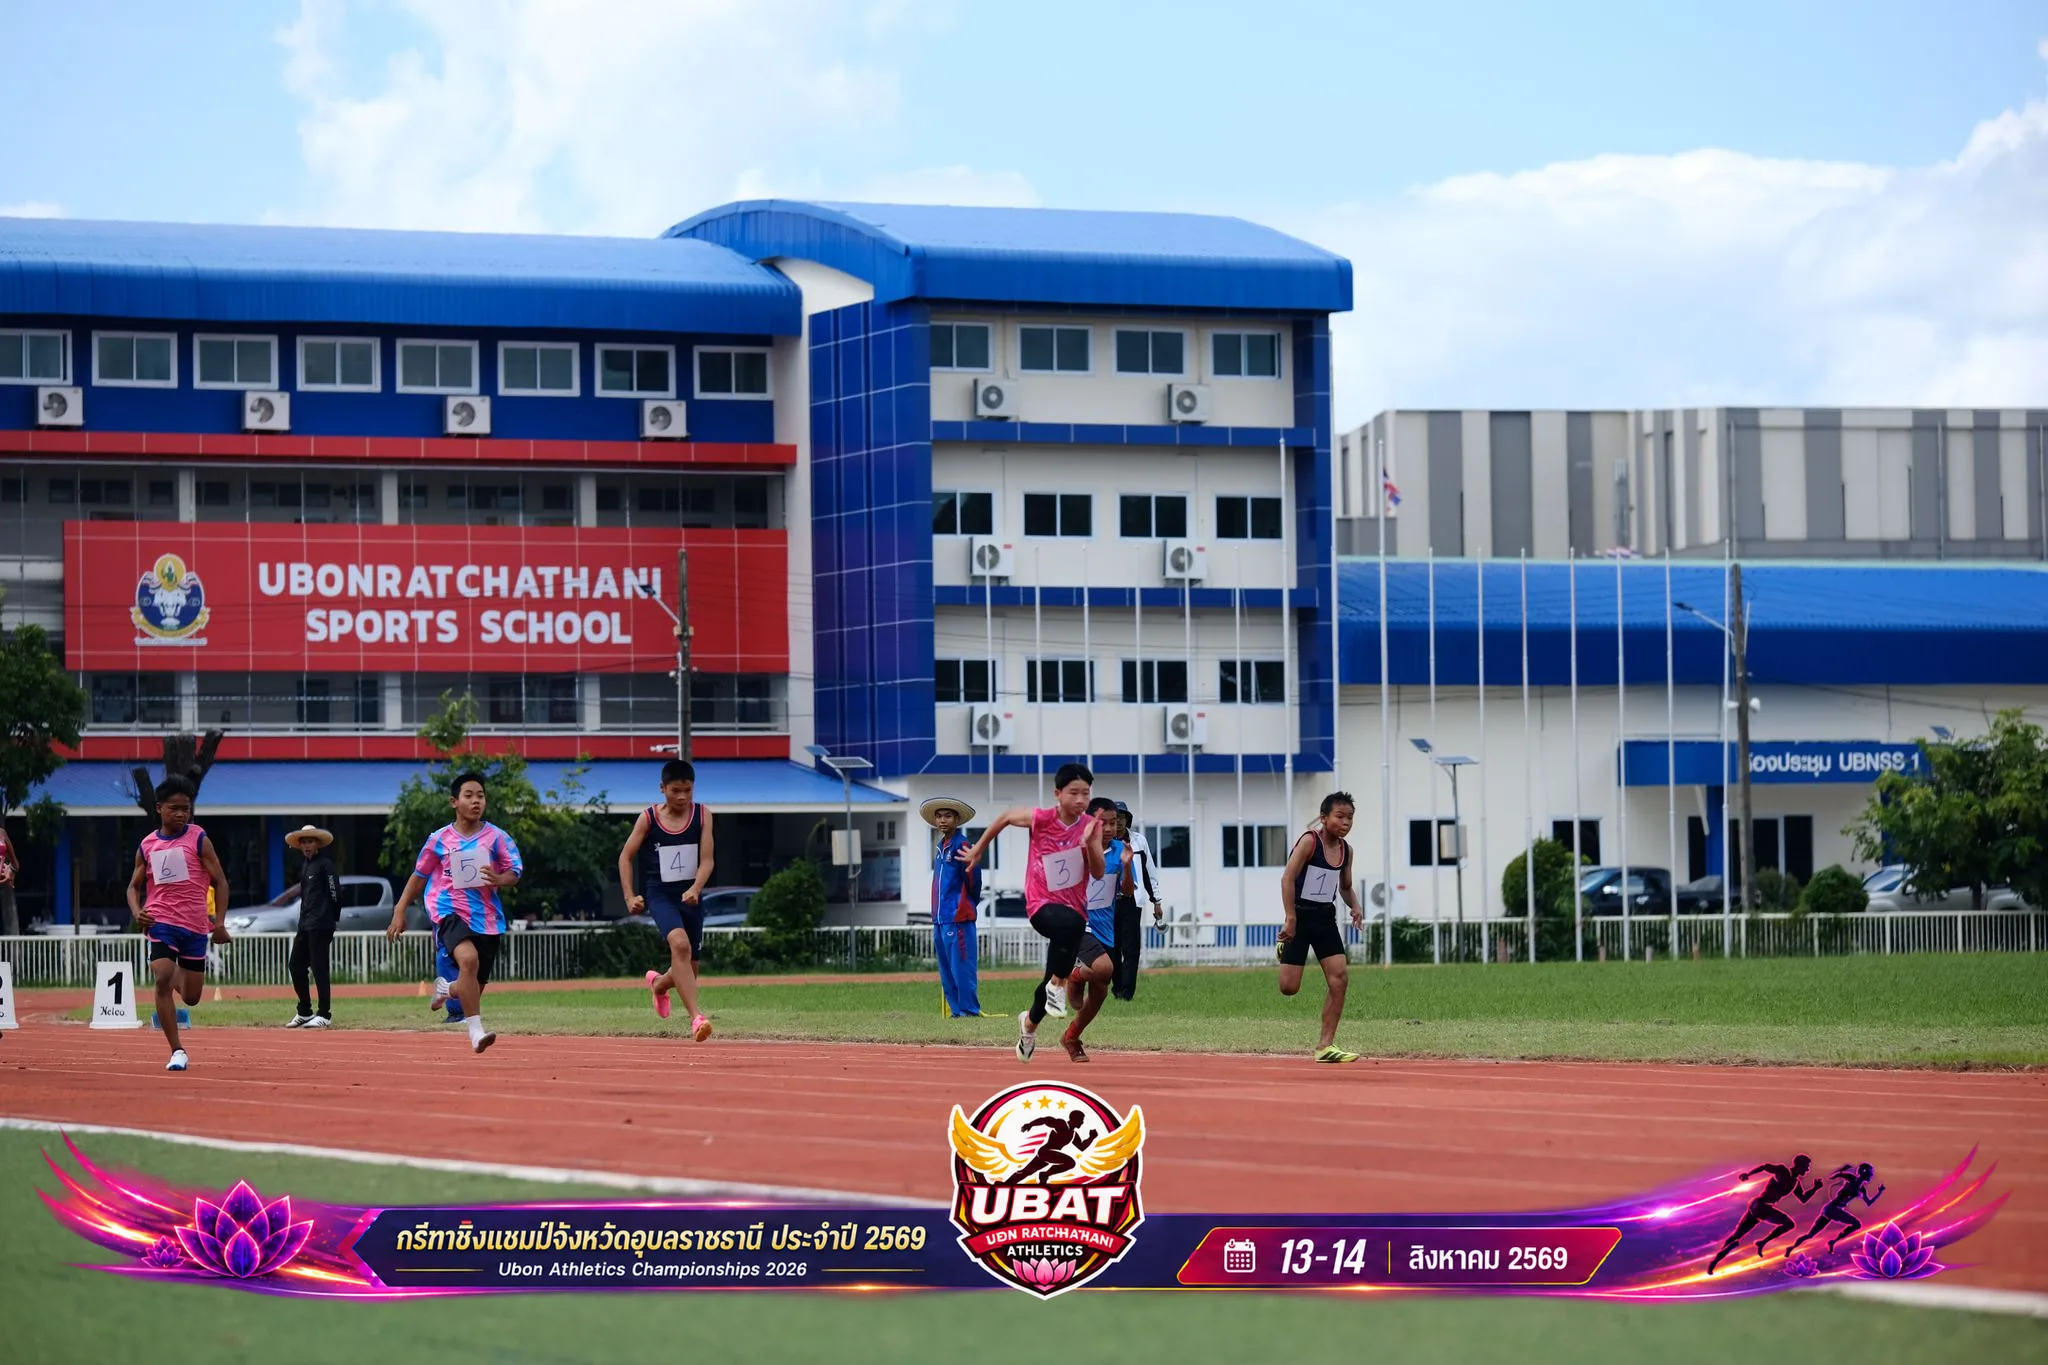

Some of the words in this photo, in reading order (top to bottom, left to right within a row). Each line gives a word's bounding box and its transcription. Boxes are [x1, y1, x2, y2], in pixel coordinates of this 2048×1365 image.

[258, 562, 662, 599] UBONRATCHATHANI
[306, 608, 459, 644] SPORTS
[480, 609, 632, 645] SCHOOL
[1839, 751, 1905, 772] UBNSS
[1911, 752, 1920, 770] 1
[161, 855, 173, 878] 6
[460, 858, 478, 883] 5
[670, 851, 686, 873] 4
[1054, 859, 1071, 886] 3
[1088, 879, 1106, 903] 2
[1310, 872, 1328, 896] 1
[107, 971, 124, 1005] 1
